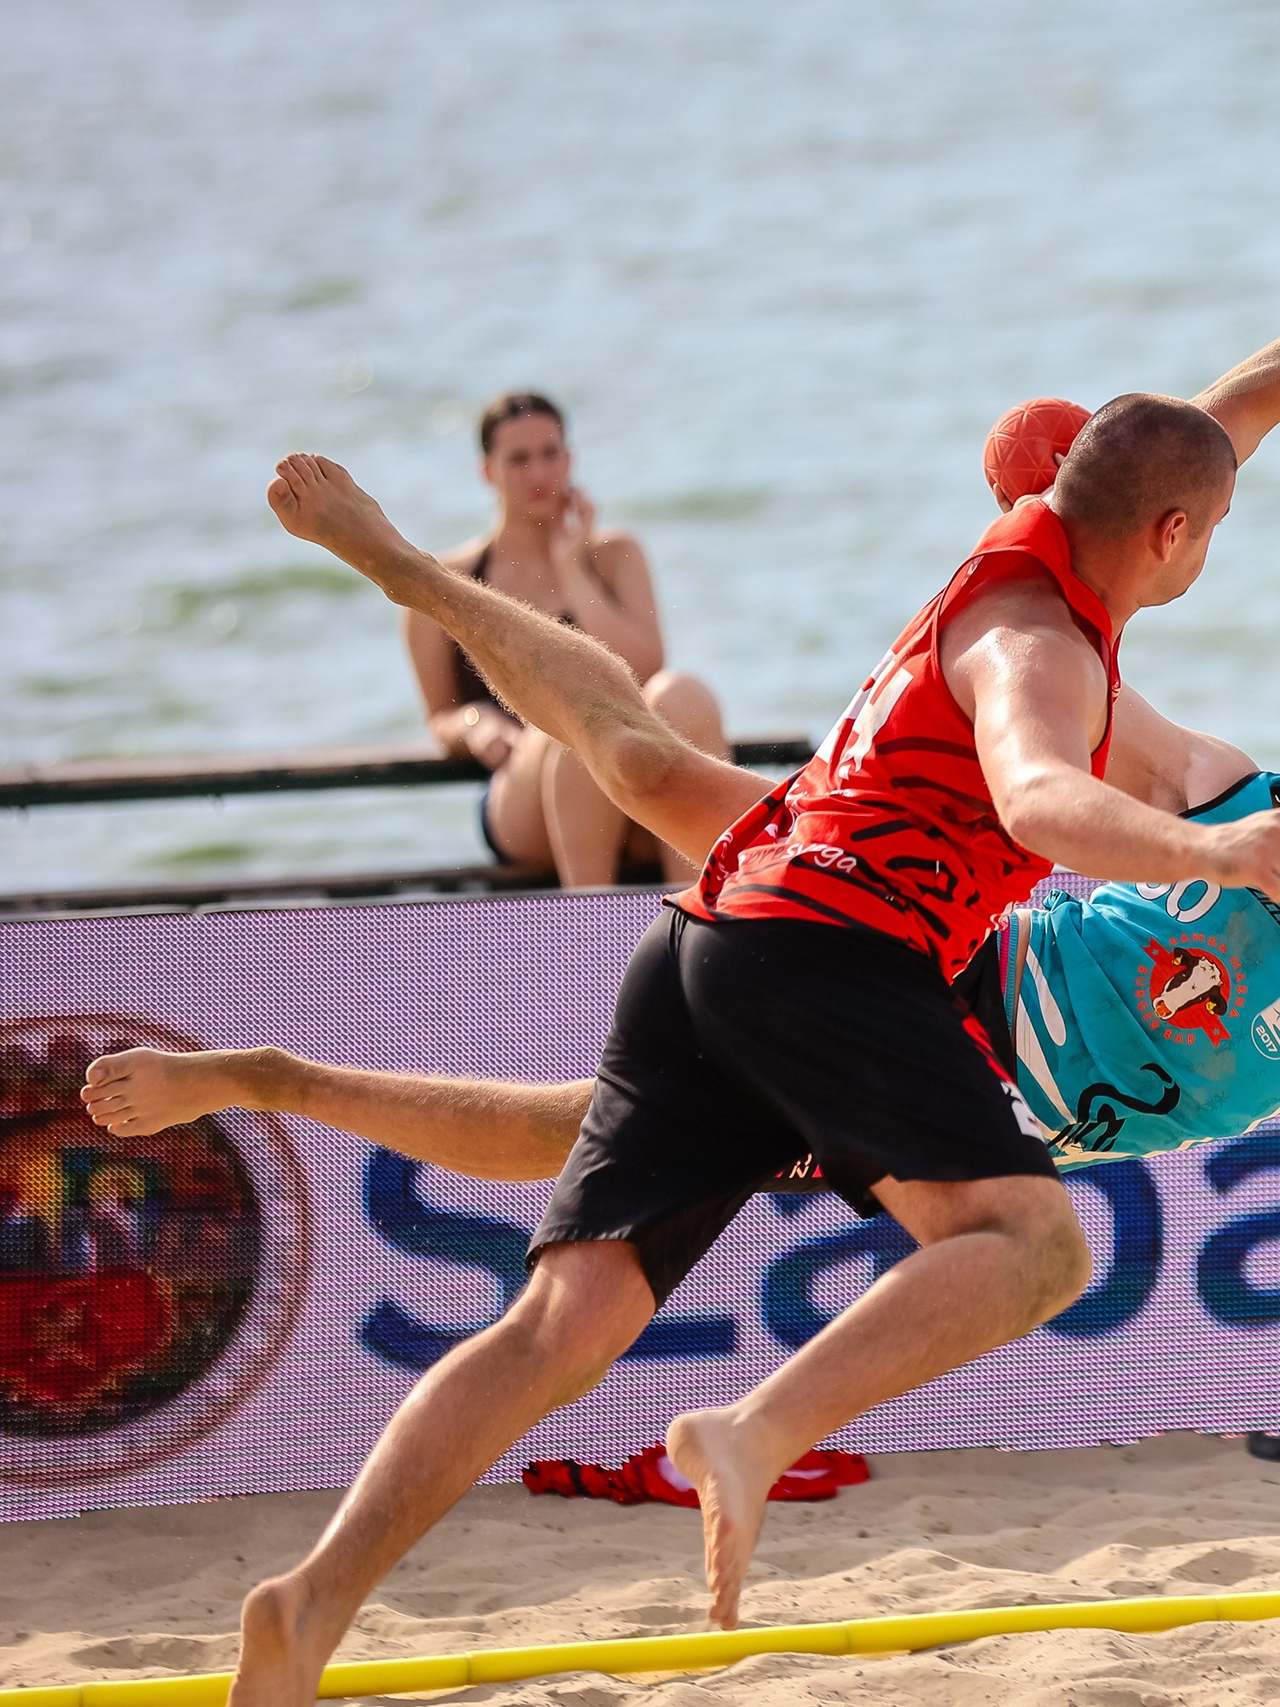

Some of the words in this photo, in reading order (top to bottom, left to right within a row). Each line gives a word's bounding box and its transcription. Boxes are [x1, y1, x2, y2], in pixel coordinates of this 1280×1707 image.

[1134, 965, 1160, 1031] BURGER
[1163, 1028, 1196, 1045] BAR
[1168, 932, 1227, 954] BAMBA
[1229, 956, 1248, 1018] MARHA
[1255, 1025, 1278, 1052] 2017
